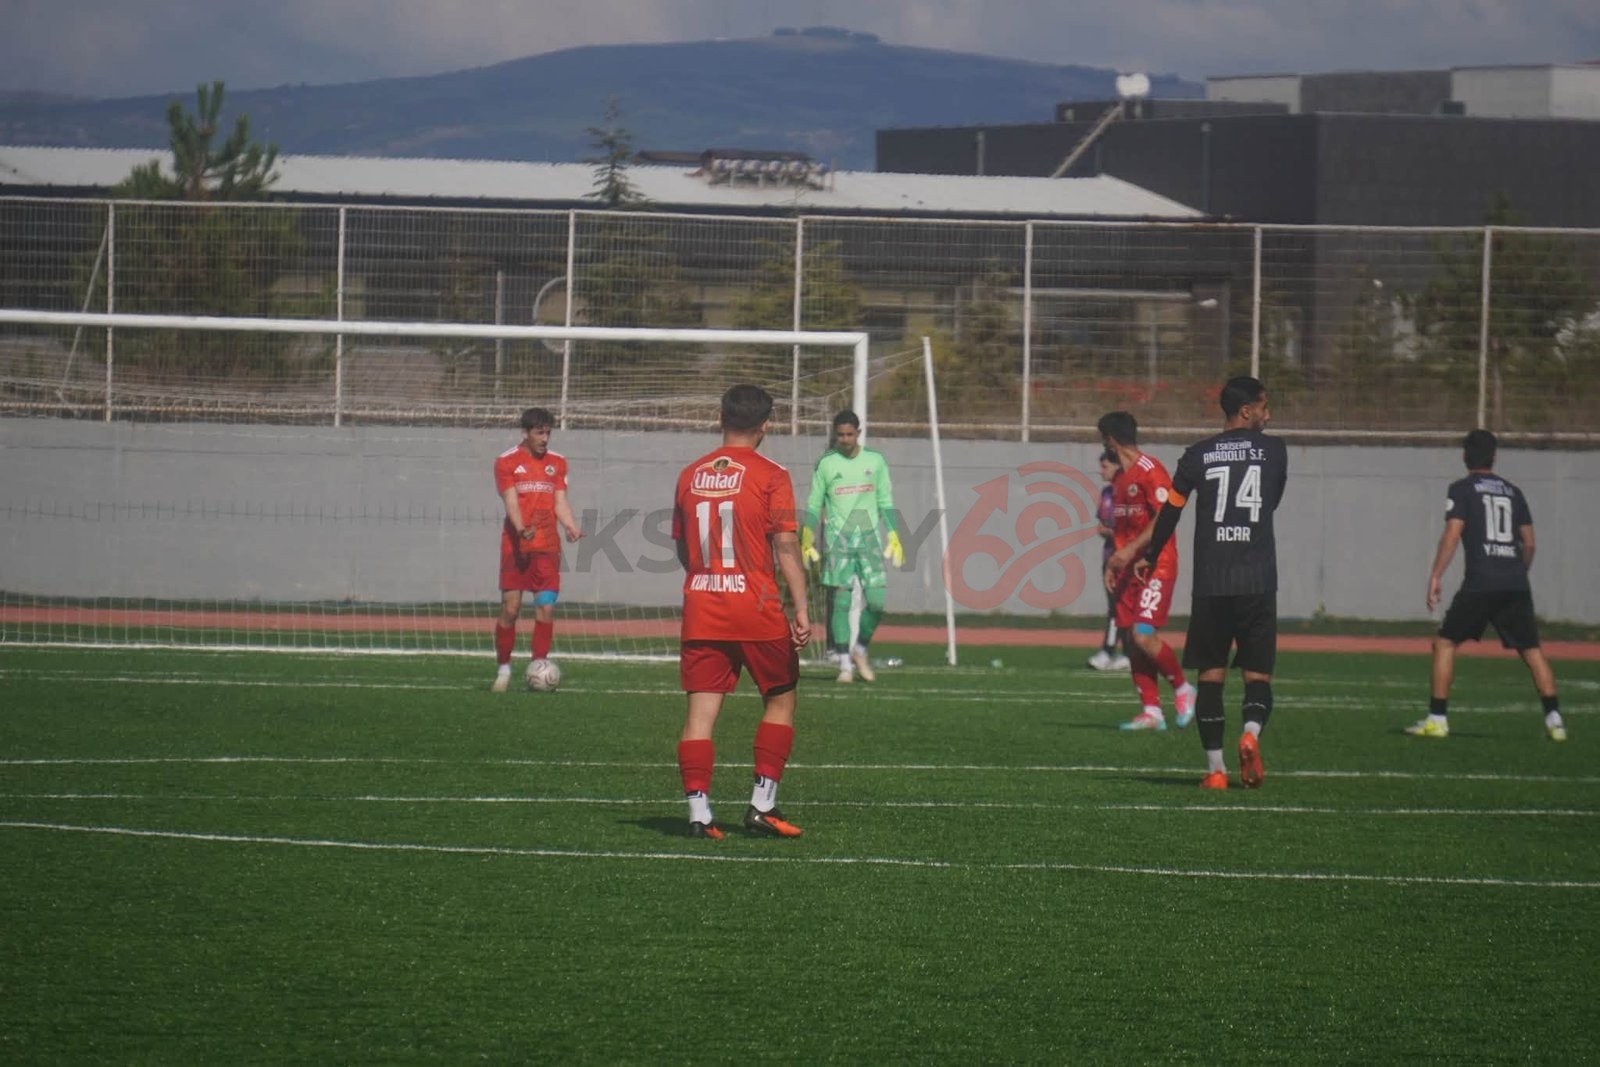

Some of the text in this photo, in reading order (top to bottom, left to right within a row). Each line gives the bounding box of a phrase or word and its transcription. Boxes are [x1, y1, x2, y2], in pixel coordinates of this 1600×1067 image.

[1203, 450, 1247, 464] ANADOLU
[1205, 465, 1263, 522] 74
[696, 501, 735, 568] 11
[1216, 526, 1251, 541] ACAR
[1482, 494, 1513, 542] 10
[1140, 588, 1162, 611] 92
